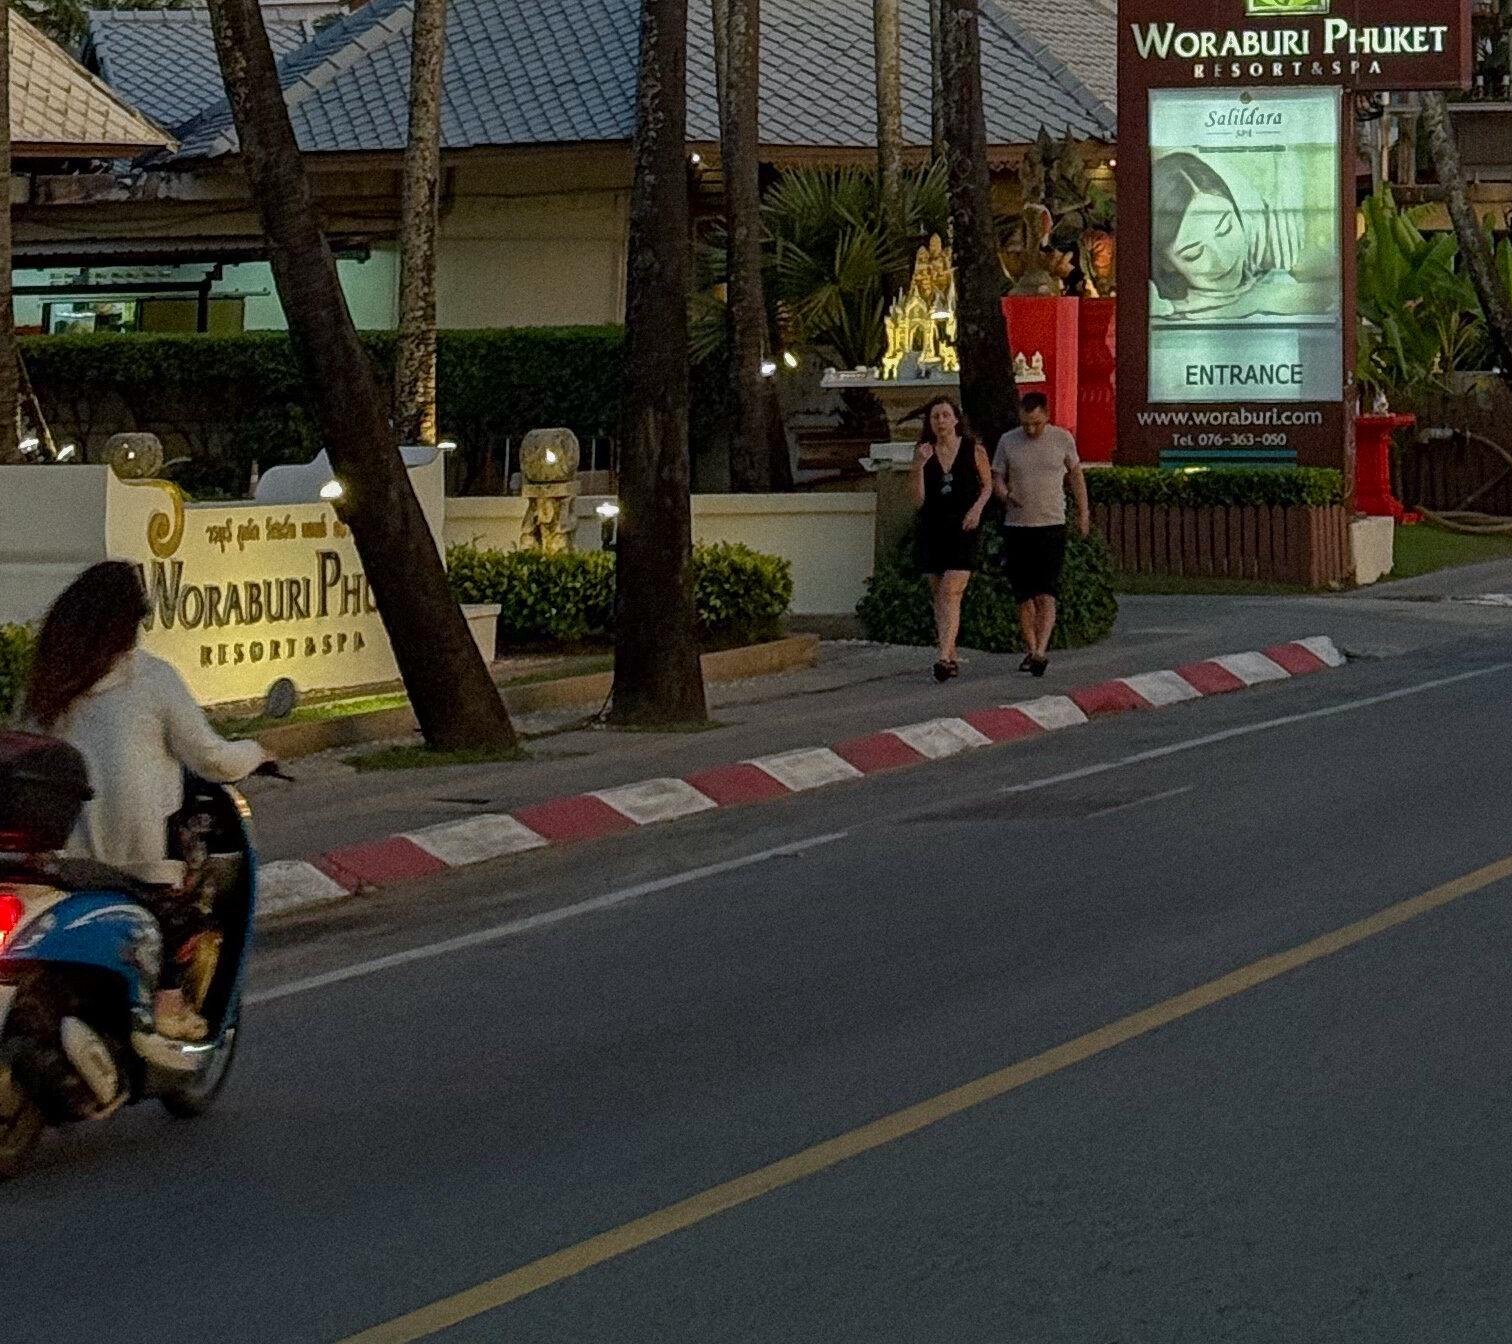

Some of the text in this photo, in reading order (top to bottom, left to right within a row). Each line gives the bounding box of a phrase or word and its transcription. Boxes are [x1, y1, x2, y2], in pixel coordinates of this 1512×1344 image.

[1131, 18, 1448, 59] WORABURI PHUKET
[1204, 107, 1282, 128] Salildara
[1186, 364, 1303, 386] ENTRANCE
[1137, 408, 1323, 426] www.woraburi.com
[1199, 433, 1287, 446] 076-363-050
[139, 558, 312, 632] WORABURI
